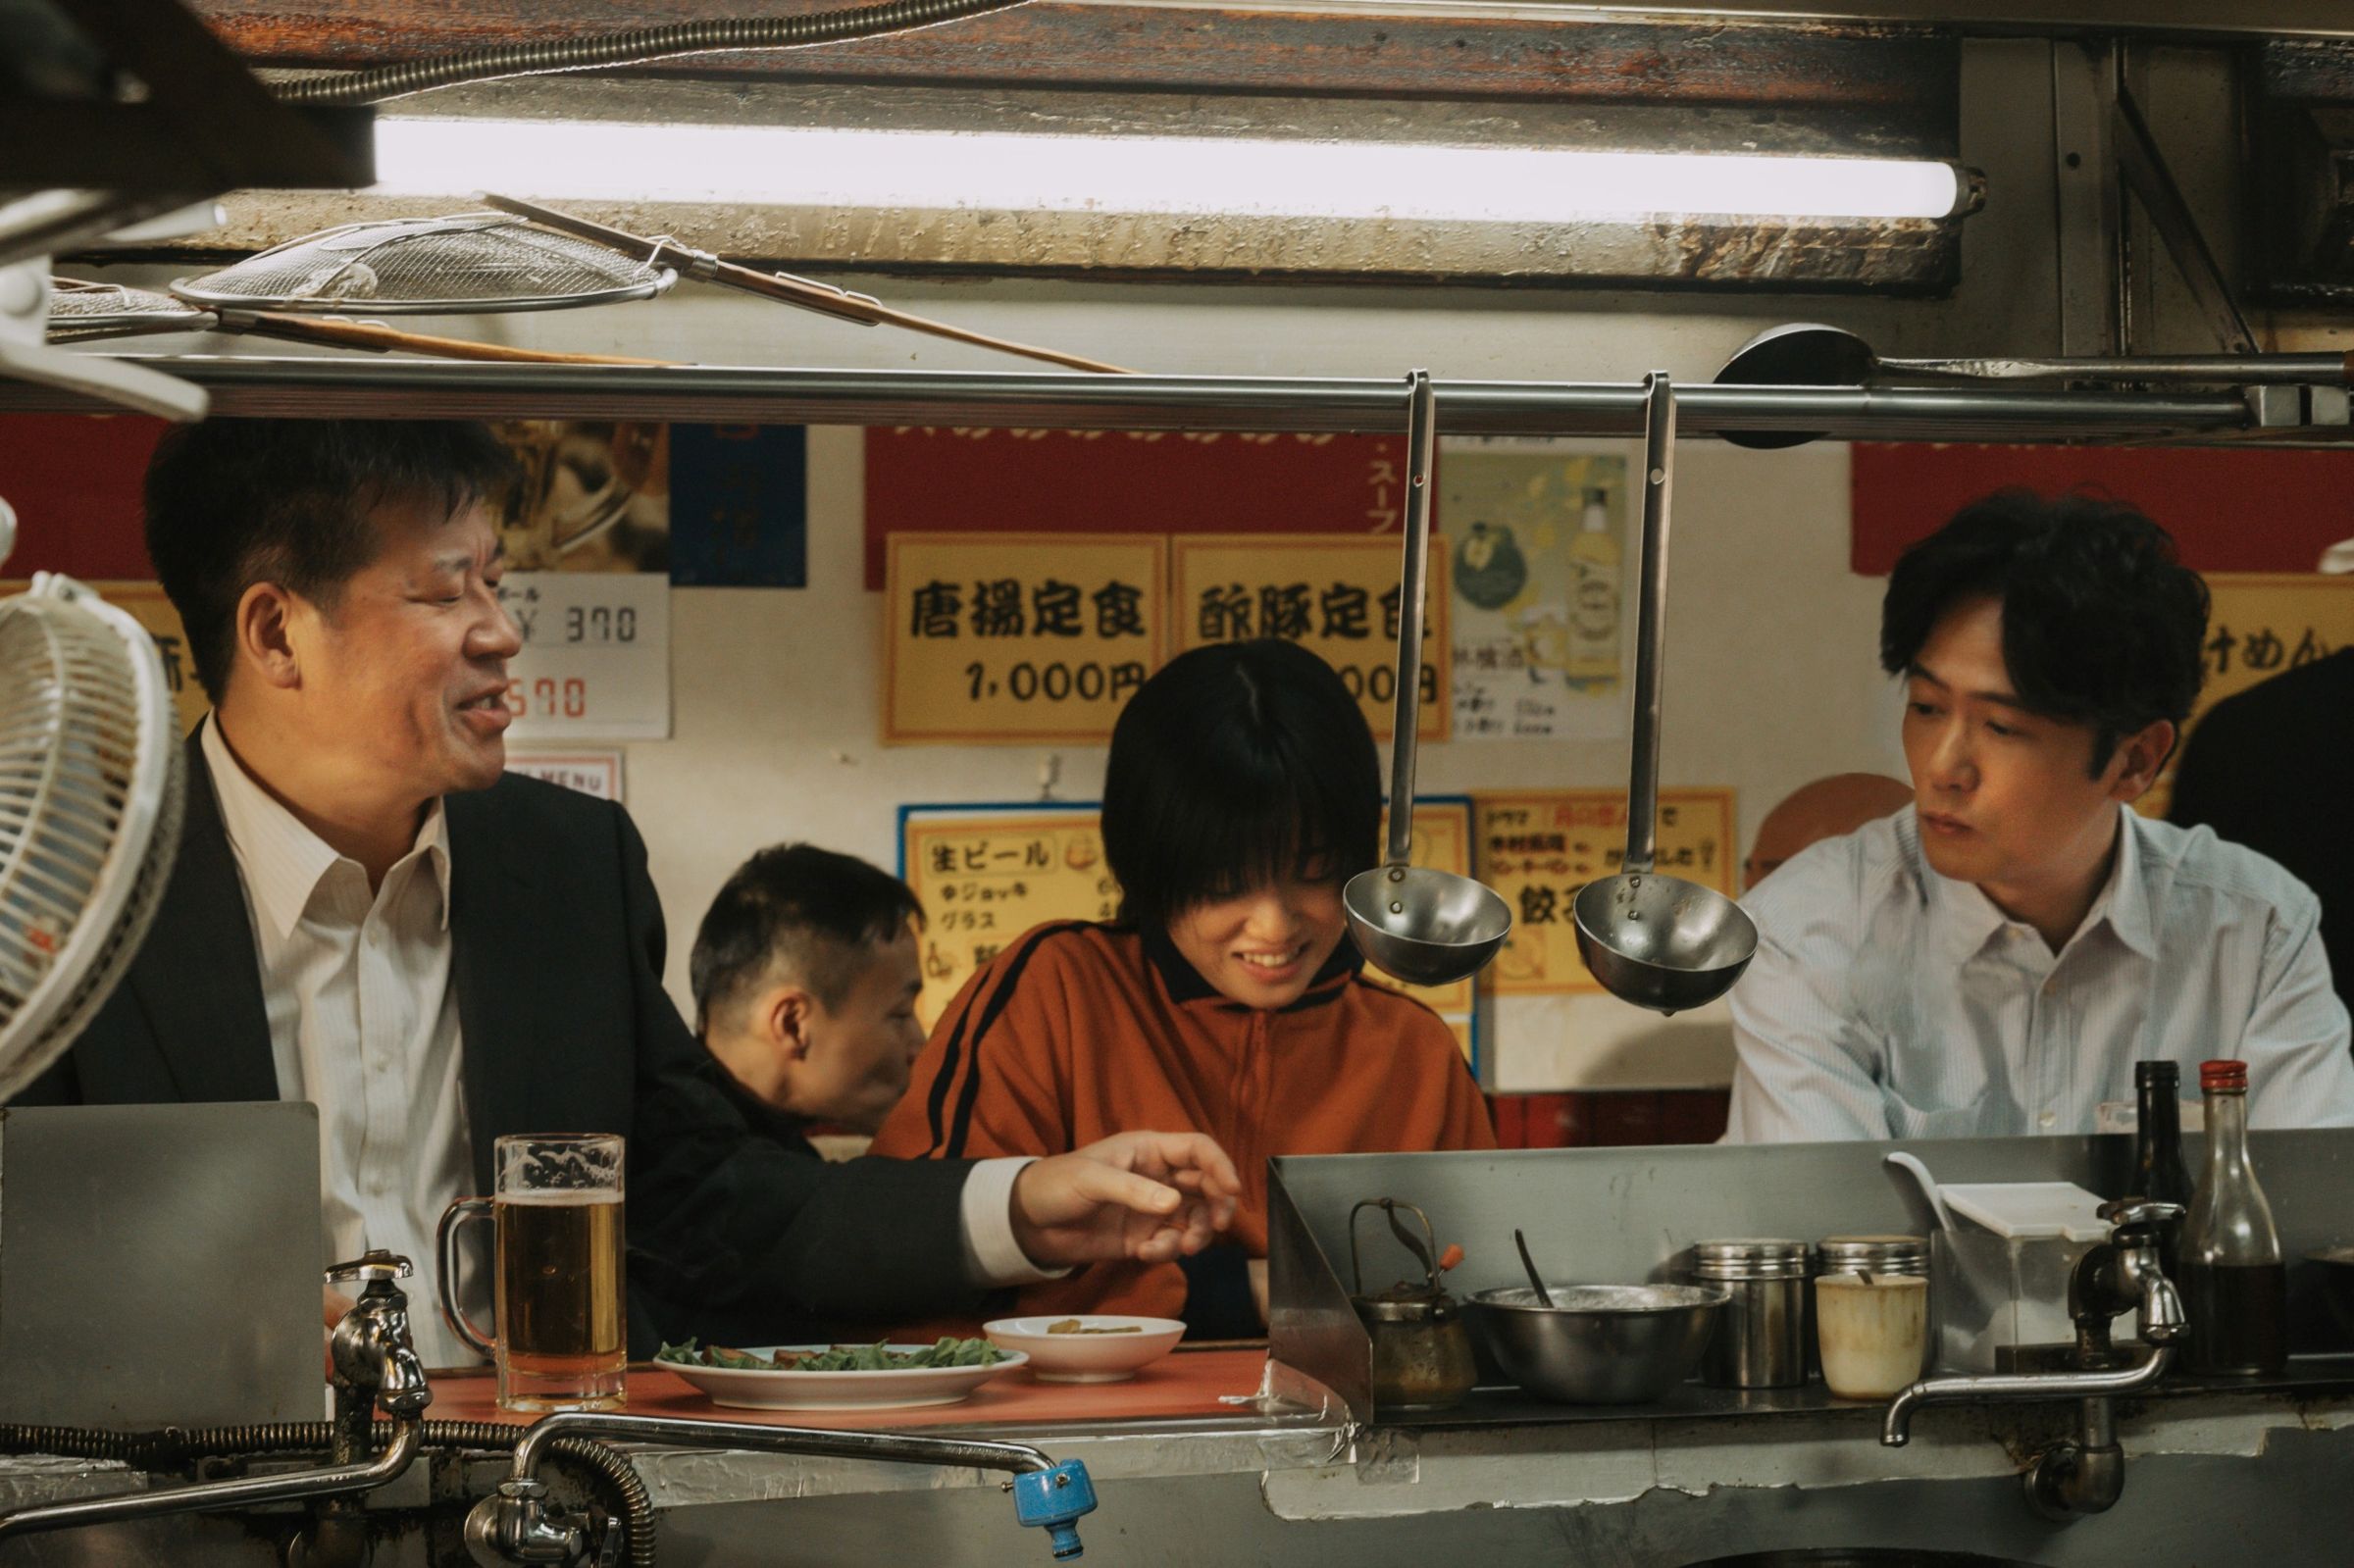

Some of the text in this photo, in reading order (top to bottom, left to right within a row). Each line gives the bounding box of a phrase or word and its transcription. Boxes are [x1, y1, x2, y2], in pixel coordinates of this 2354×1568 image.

[566, 606, 636, 642] 370
[932, 840, 1049, 872] 生ビール
[942, 912, 996, 931] グラス
